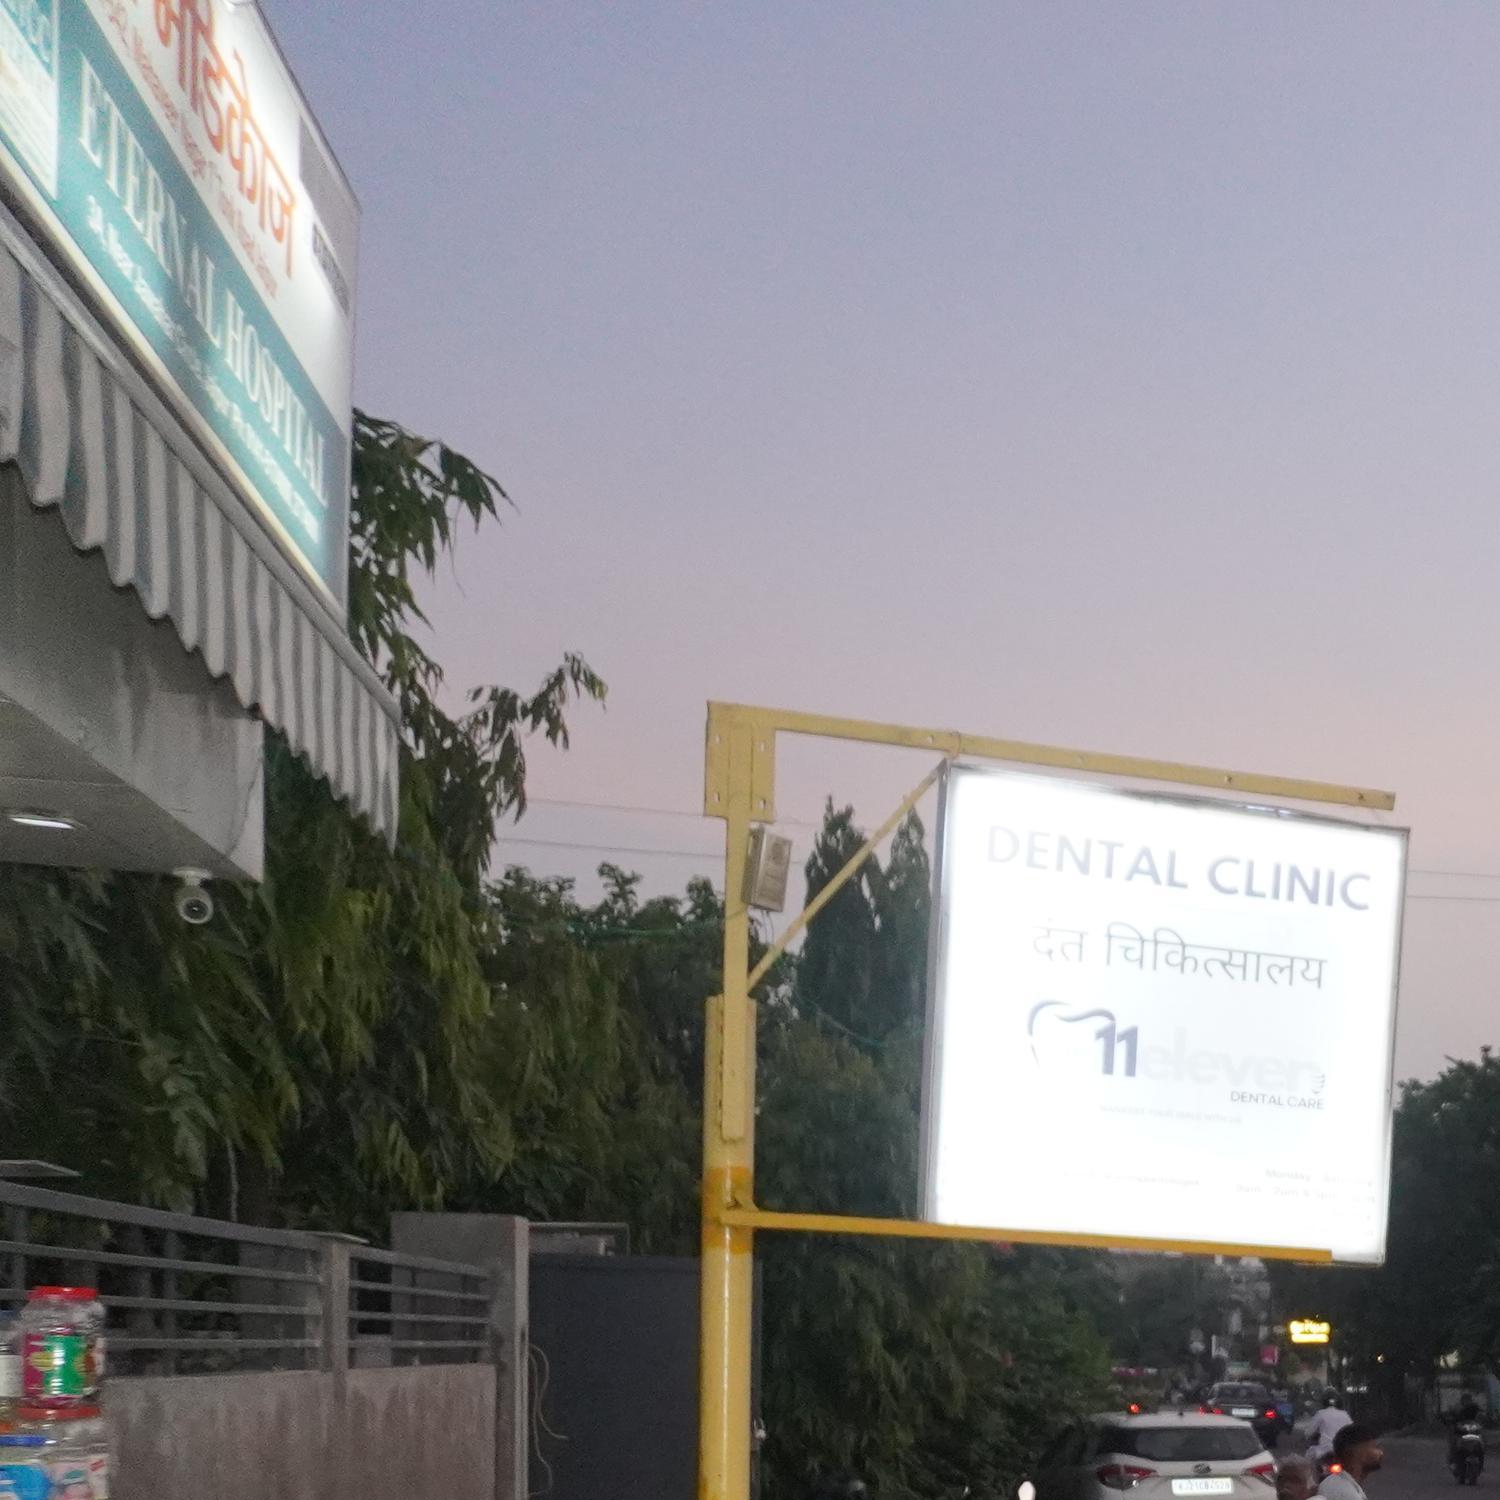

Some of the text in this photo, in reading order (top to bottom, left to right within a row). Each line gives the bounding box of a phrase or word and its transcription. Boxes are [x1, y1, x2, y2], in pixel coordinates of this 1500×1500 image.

[79, 50, 221, 348] ETERNAL
[225, 287, 327, 508] HOSPITAL
[988, 825, 1372, 911] DENTAL CLINIC
[1032, 917, 1328, 990] दंत चिकित्सालय
[1230, 1090, 1325, 1111] DENTAL CARE
